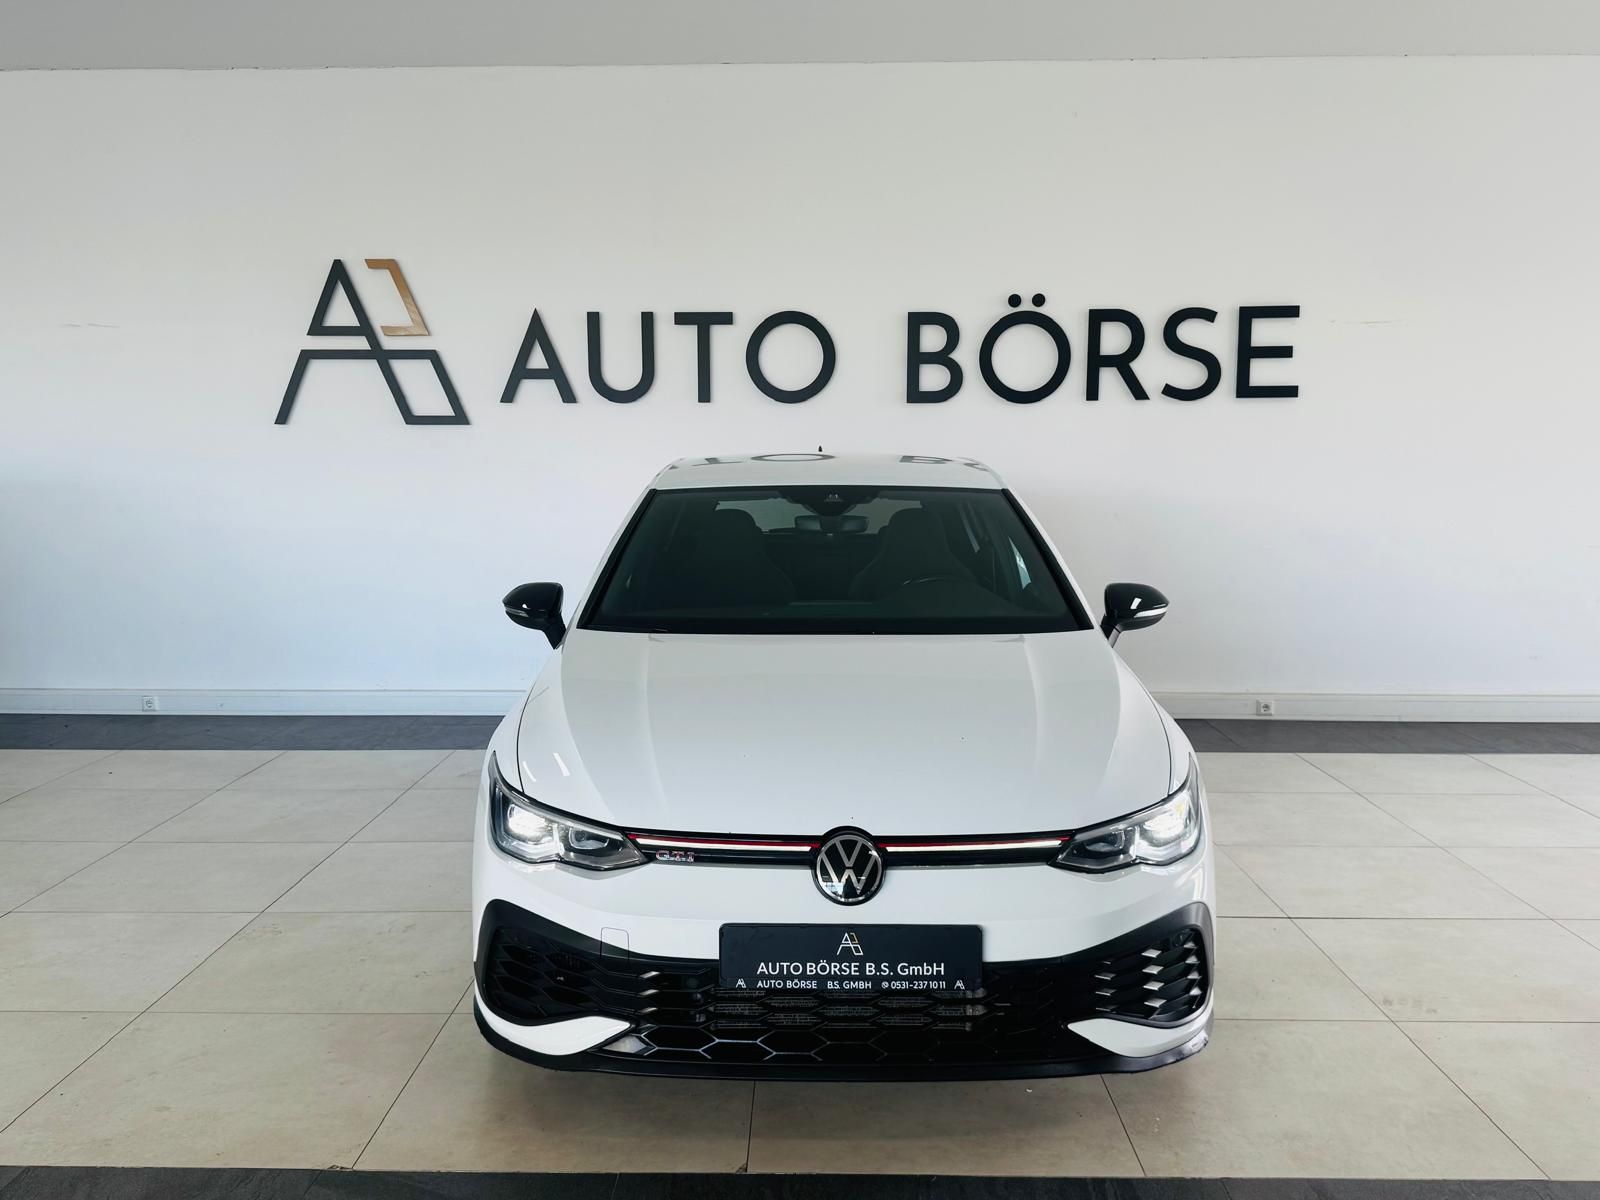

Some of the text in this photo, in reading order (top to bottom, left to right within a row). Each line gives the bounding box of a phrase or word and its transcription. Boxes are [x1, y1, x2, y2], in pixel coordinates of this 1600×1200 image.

[500, 293, 1301, 405] AUTO BÖRSE
[655, 850, 695, 863] GTI
[756, 959, 945, 976] AUTO BÖRSE B.S. GmbH
[756, 980, 784, 989] AUTO
[786, 978, 818, 989] BÖRSE
[842, 980, 872, 990] GMBH
